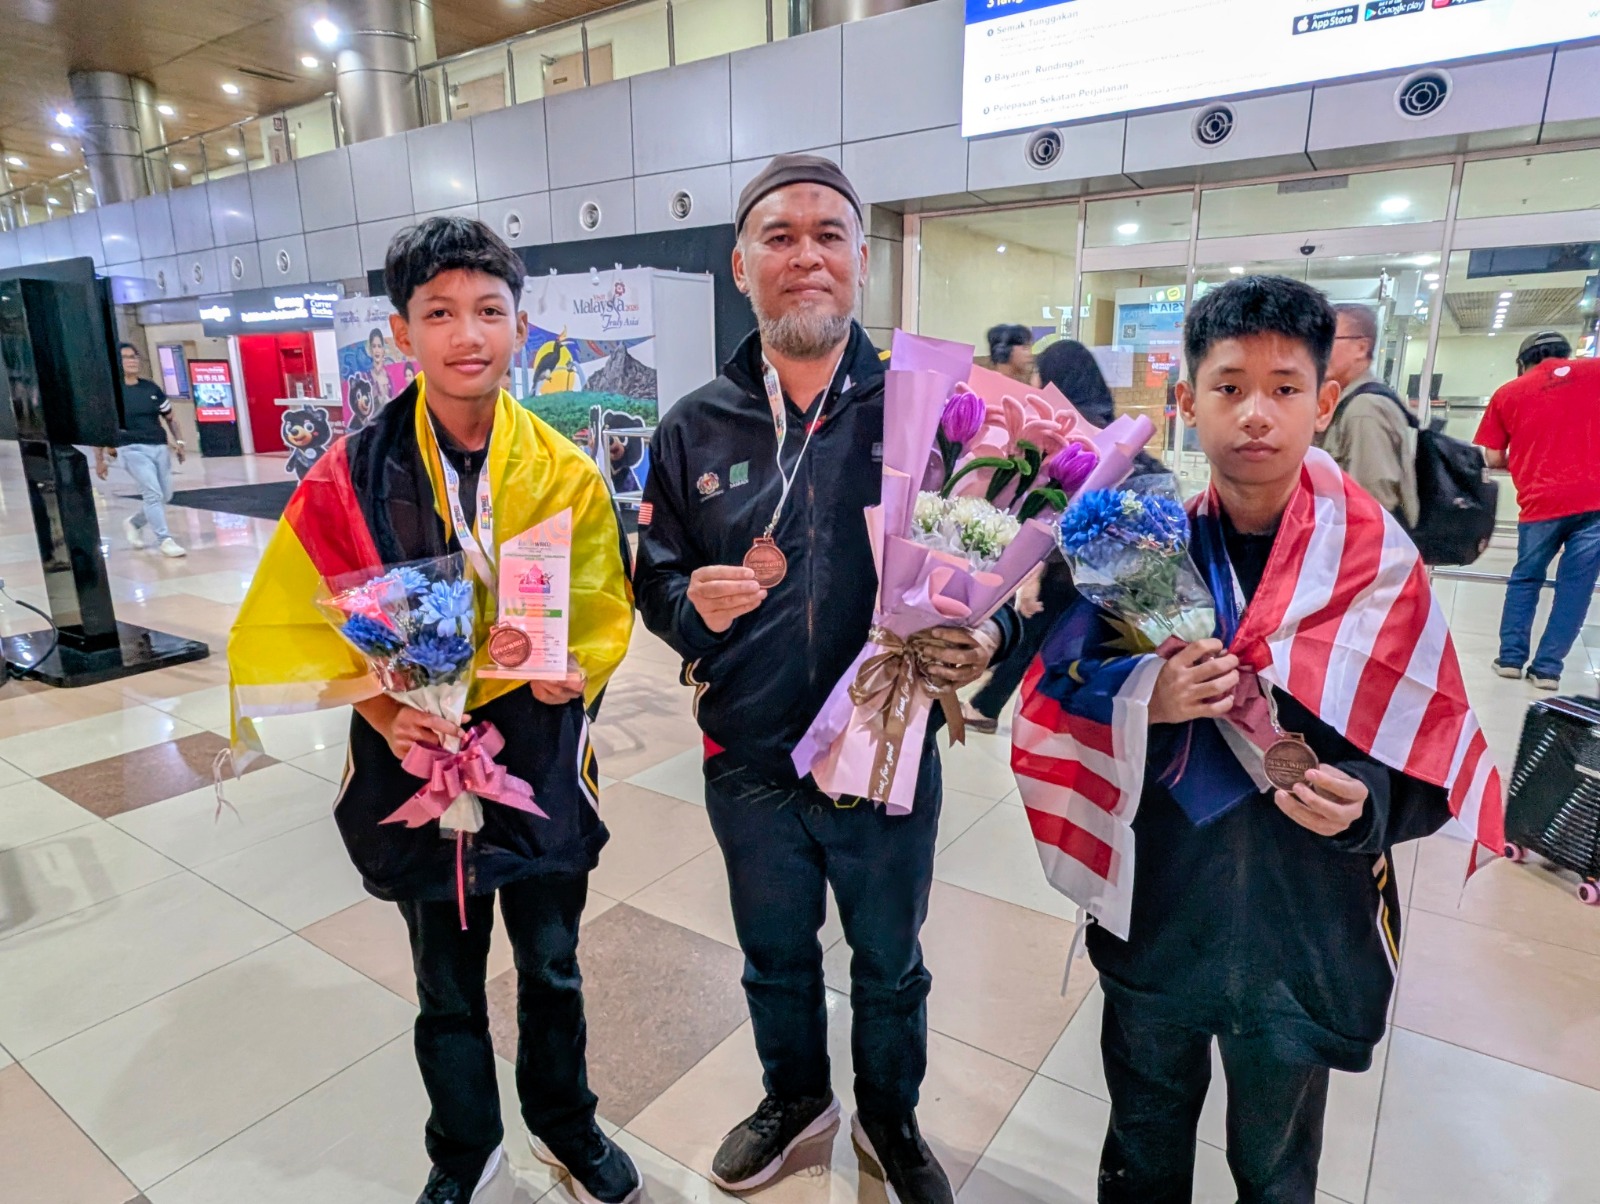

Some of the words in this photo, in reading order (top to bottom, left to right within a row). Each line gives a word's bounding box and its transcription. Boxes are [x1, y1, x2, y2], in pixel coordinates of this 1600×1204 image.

[1377, 3, 1406, 16] Google
[1406, 0, 1424, 11] play
[996, 21, 1025, 35] Semak
[1029, 10, 1079, 28] Tunggakan
[1311, 19, 1330, 30] App
[1329, 15, 1354, 26] Store
[994, 69, 1030, 82] Bayaran
[1035, 57, 1085, 75] Rundingan
[993, 99, 1037, 113] Pelepasan
[1040, 92, 1076, 105] Sekatan
[1078, 82, 1129, 98] Perjalanan
[573, 297, 625, 315] Malaysia
[600, 314, 624, 332] Truly
[623, 317, 639, 326] Asia
